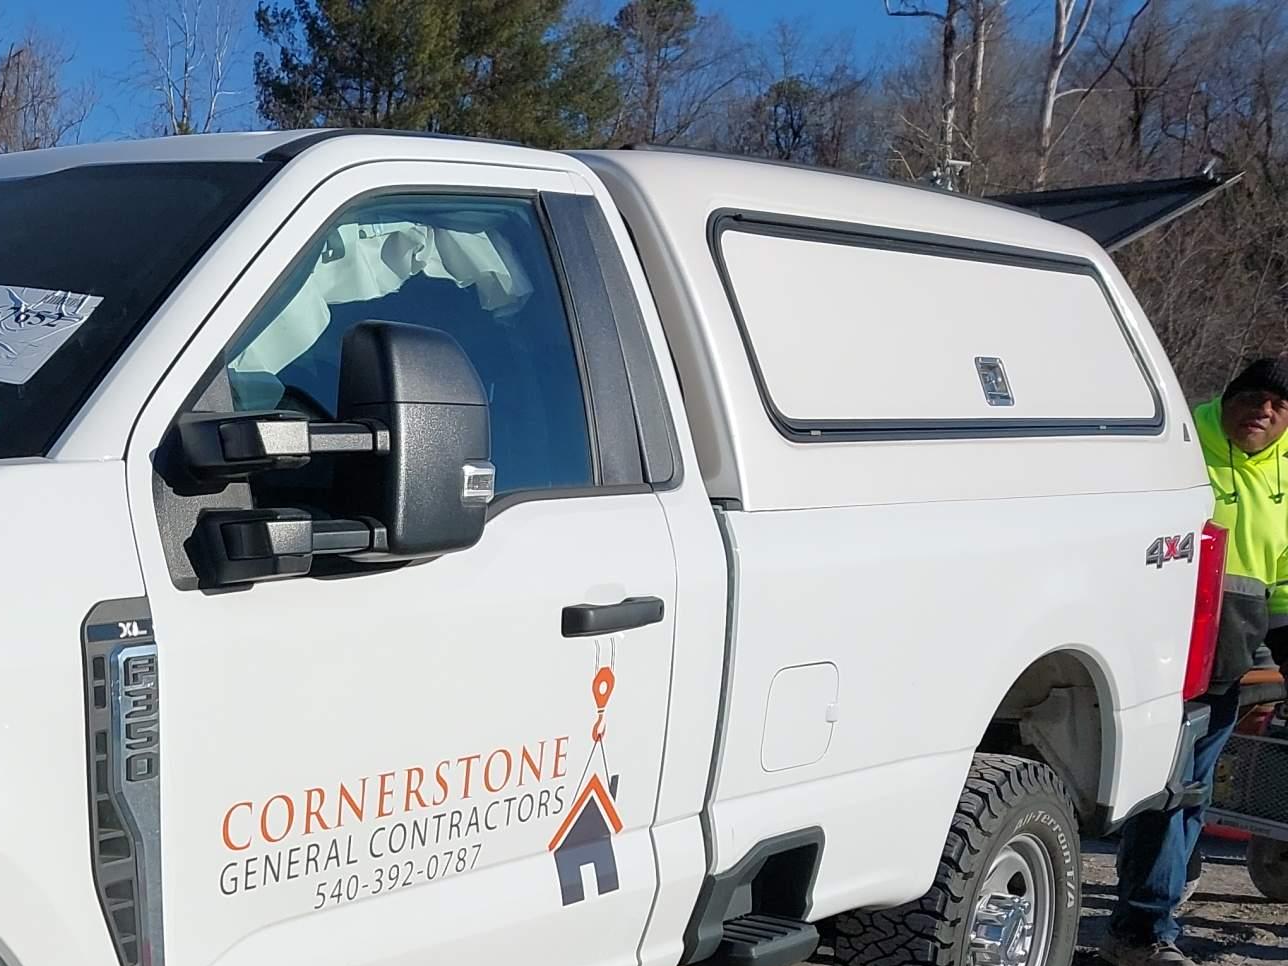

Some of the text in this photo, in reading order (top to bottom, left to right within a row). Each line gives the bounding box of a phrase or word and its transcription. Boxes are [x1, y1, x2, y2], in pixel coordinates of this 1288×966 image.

[118, 620, 148, 638] XL
[221, 736, 570, 852] CORNERSTONE
[219, 785, 565, 896] GENERAL CONTRACTORS
[314, 843, 482, 910] 540-392-0787
[1066, 866, 1076, 909] T/A
